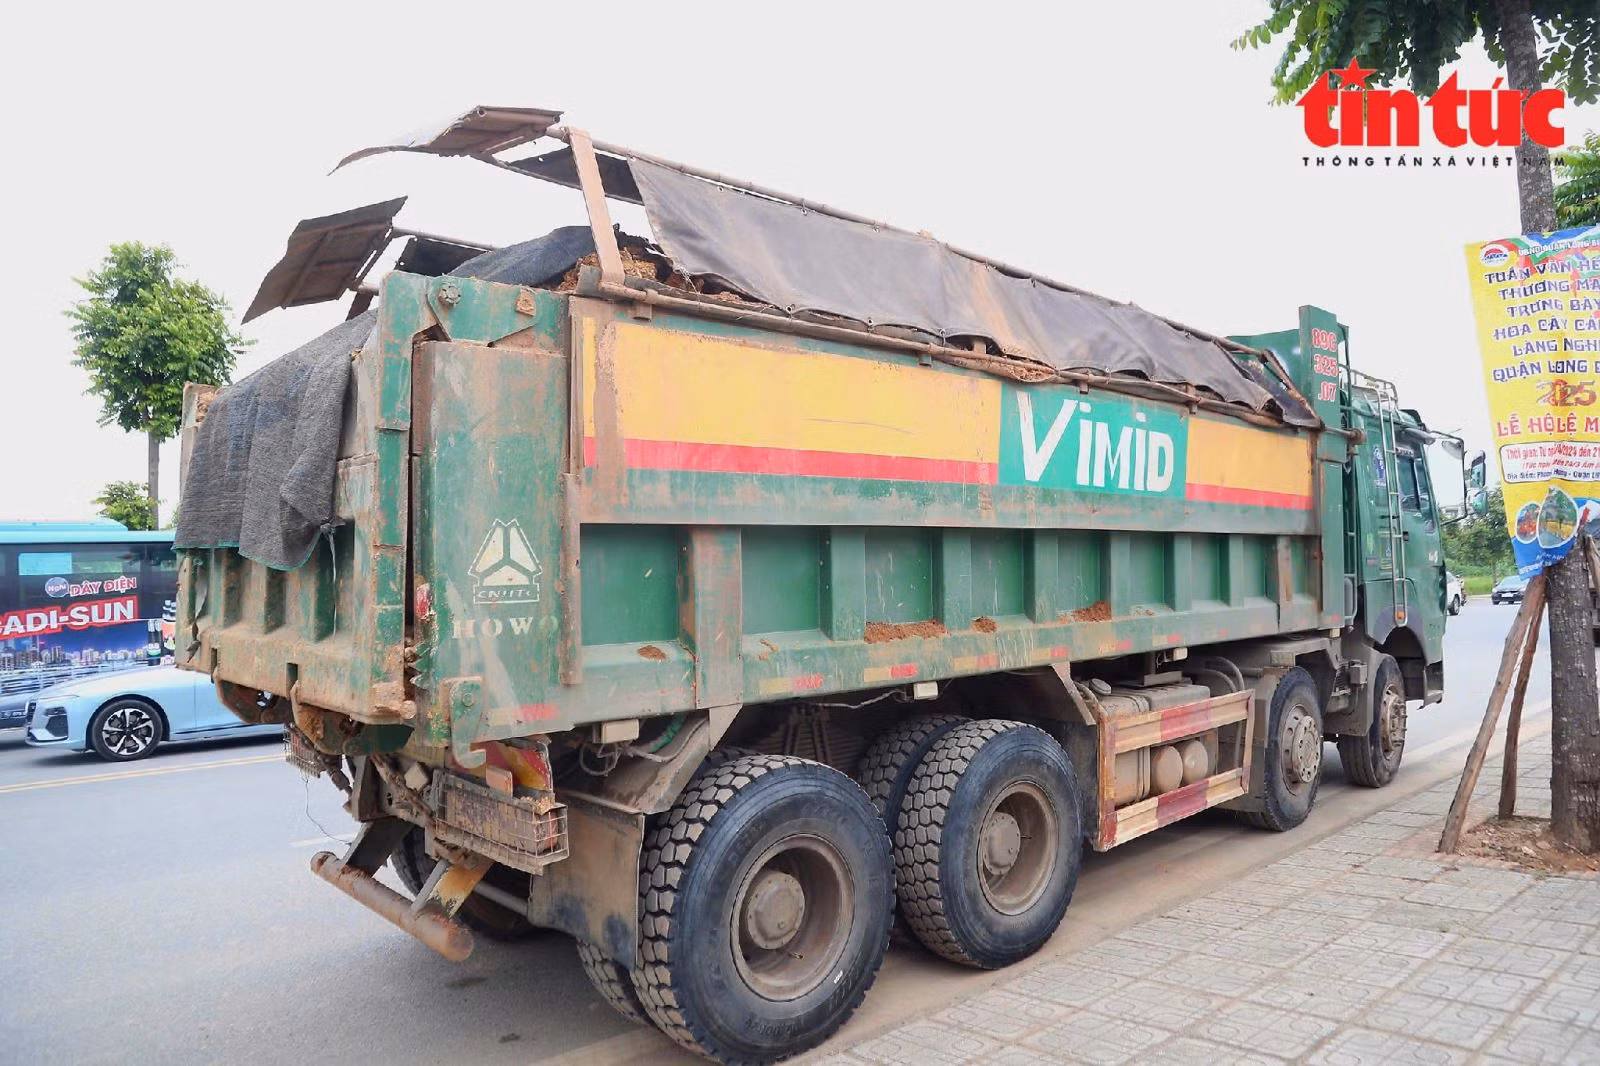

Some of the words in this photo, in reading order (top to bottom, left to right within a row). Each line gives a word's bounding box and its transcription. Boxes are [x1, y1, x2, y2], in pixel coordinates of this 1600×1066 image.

[1499, 280, 1570, 300] THƯƠNG
[1507, 299, 1564, 318] TRƯNG
[1493, 323, 1532, 340] HOA
[1538, 315, 1568, 331] CÂY
[1574, 315, 1600, 331] CẢ
[1513, 338, 1558, 357] LÀNG
[1563, 337, 1600, 352] NGH
[1313, 354, 1339, 377] 325
[1493, 361, 1541, 382] QUẬN
[1548, 359, 1588, 374] LONG
[1497, 413, 1521, 438] LỄ
[70, 580, 102, 597] DÂY
[103, 575, 137, 593] ĐIỆN
[0, 600, 134, 636] ADI-SUN
